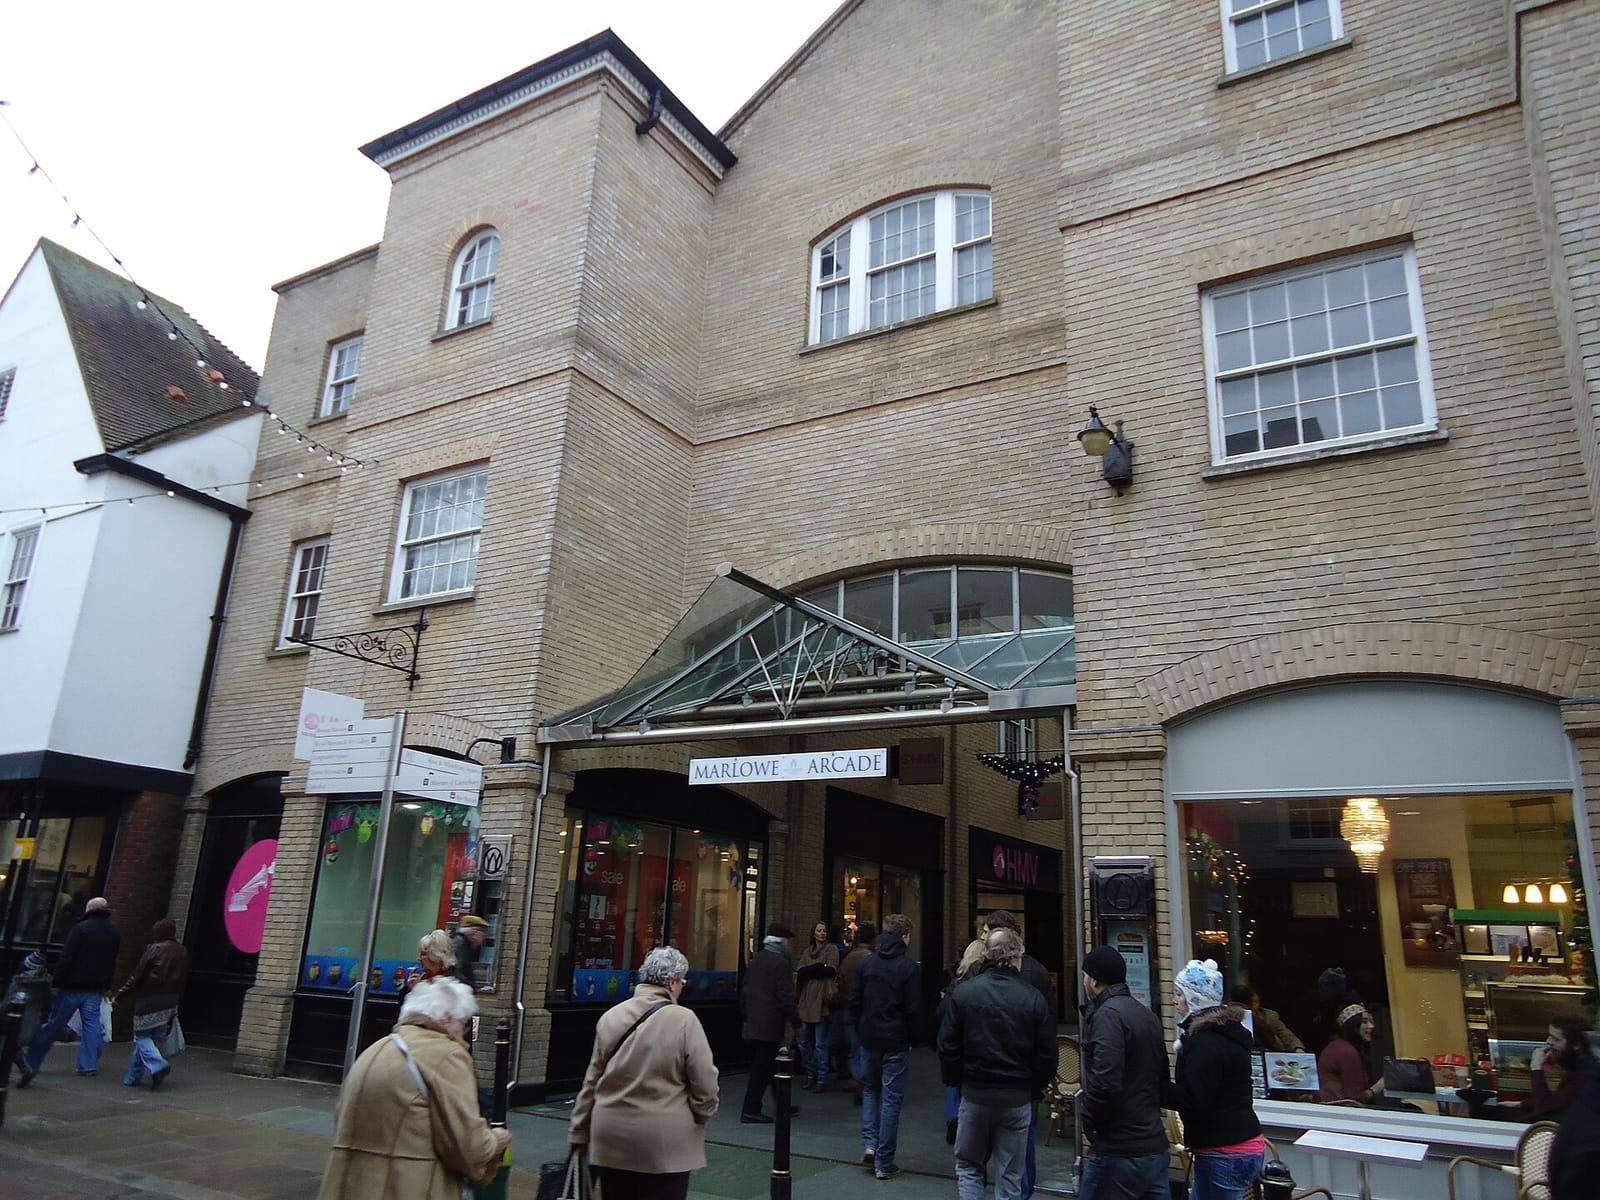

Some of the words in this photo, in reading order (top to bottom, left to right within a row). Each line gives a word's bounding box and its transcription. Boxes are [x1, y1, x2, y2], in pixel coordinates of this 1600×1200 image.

[694, 760, 779, 779] MARLOWE
[807, 754, 881, 774] ARCADE
[600, 869, 624, 885] sale
[1007, 848, 1039, 886] HMV
